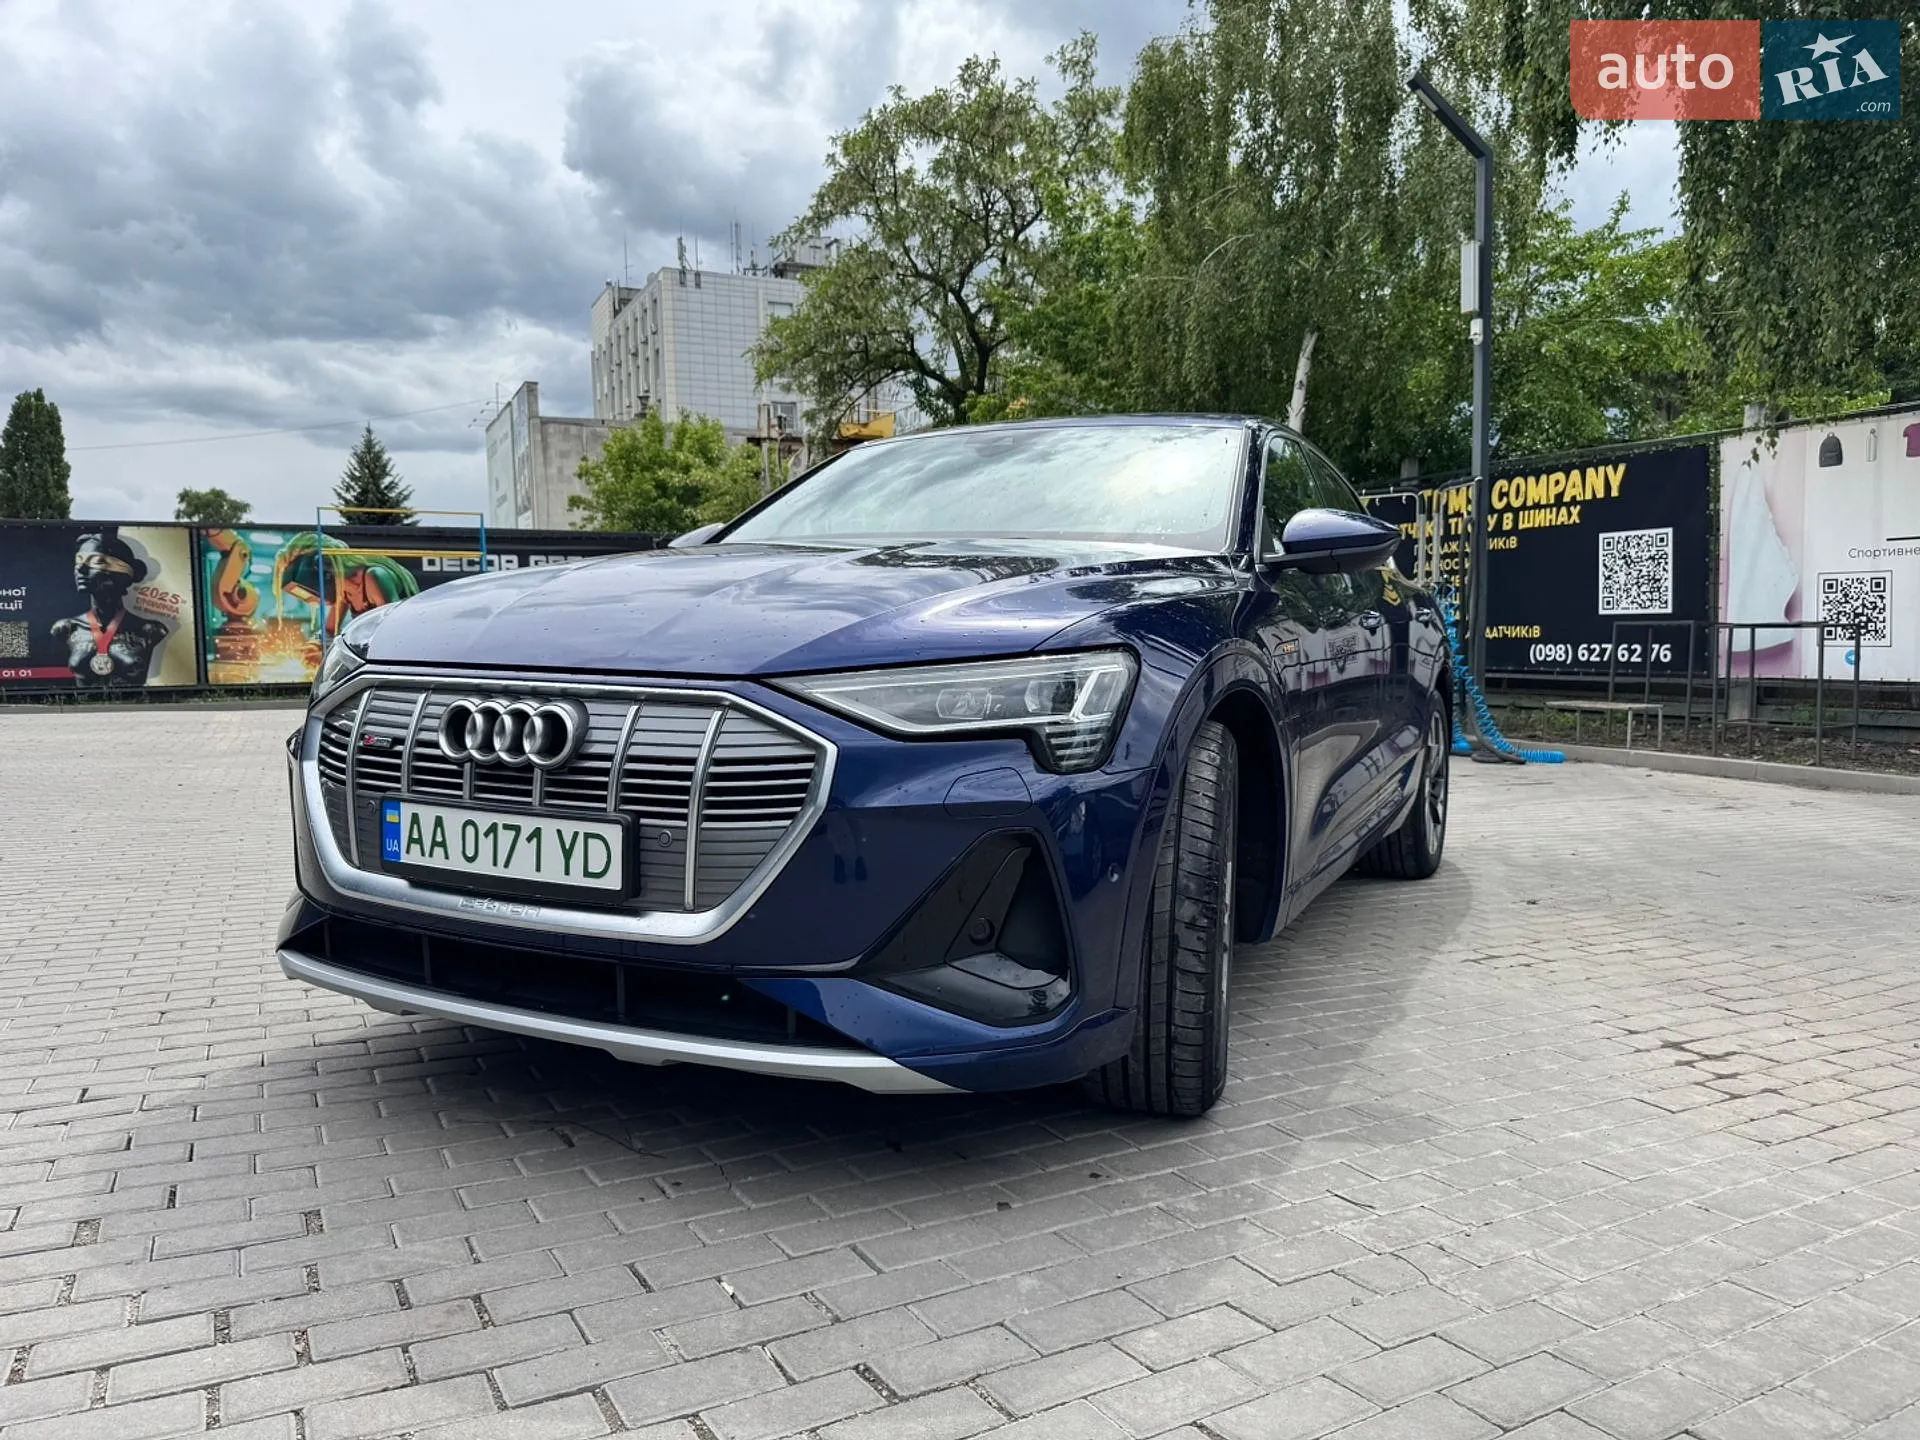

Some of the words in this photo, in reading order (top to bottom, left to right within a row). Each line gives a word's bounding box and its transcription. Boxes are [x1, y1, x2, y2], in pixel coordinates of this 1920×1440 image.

[1490, 463, 1627, 510] COMPANY
[1518, 504, 1581, 530] ШИНАХ
[422, 554, 518, 572] DECOR
[0, 586, 27, 597] ної
[138, 586, 181, 605] 2025
[1529, 643, 1573, 664] (098)
[1577, 643, 1613, 662] 627
[1617, 643, 1643, 662] 62
[1650, 643, 1672, 662] 76
[386, 838, 400, 852] UA
[405, 812, 450, 861] AA
[461, 818, 542, 873] 0171
[556, 828, 612, 879] YD
